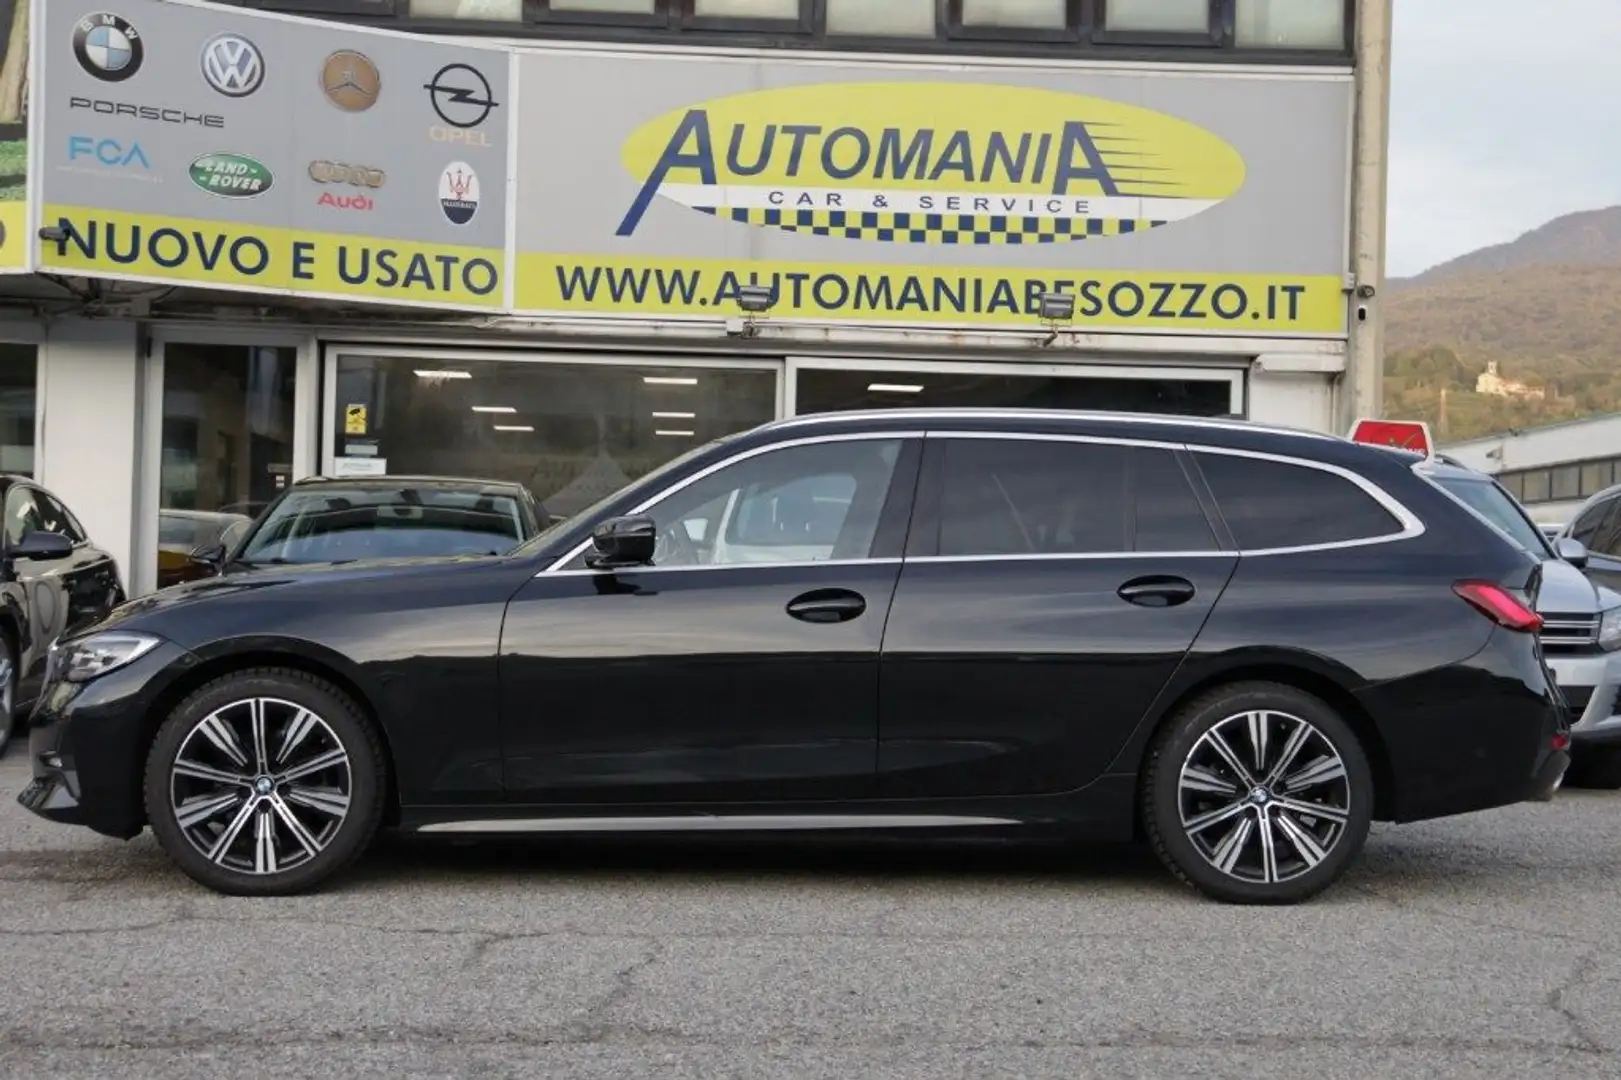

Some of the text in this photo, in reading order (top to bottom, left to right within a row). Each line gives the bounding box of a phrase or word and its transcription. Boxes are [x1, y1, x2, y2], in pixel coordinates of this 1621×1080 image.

[80, 14, 138, 40] BMW
[70, 97, 225, 128] PORSCHE
[429, 126, 493, 147] OPEL
[69, 136, 150, 169] FCA
[205, 161, 248, 175] LAND
[615, 109, 1119, 236] AUTOMANIA
[208, 174, 262, 190] ROVER
[317, 192, 374, 211] Audi
[768, 191, 1089, 214] CAR & SERVICE
[58, 218, 269, 275] NUOVO
[293, 242, 315, 279] E
[338, 246, 498, 295] USATO
